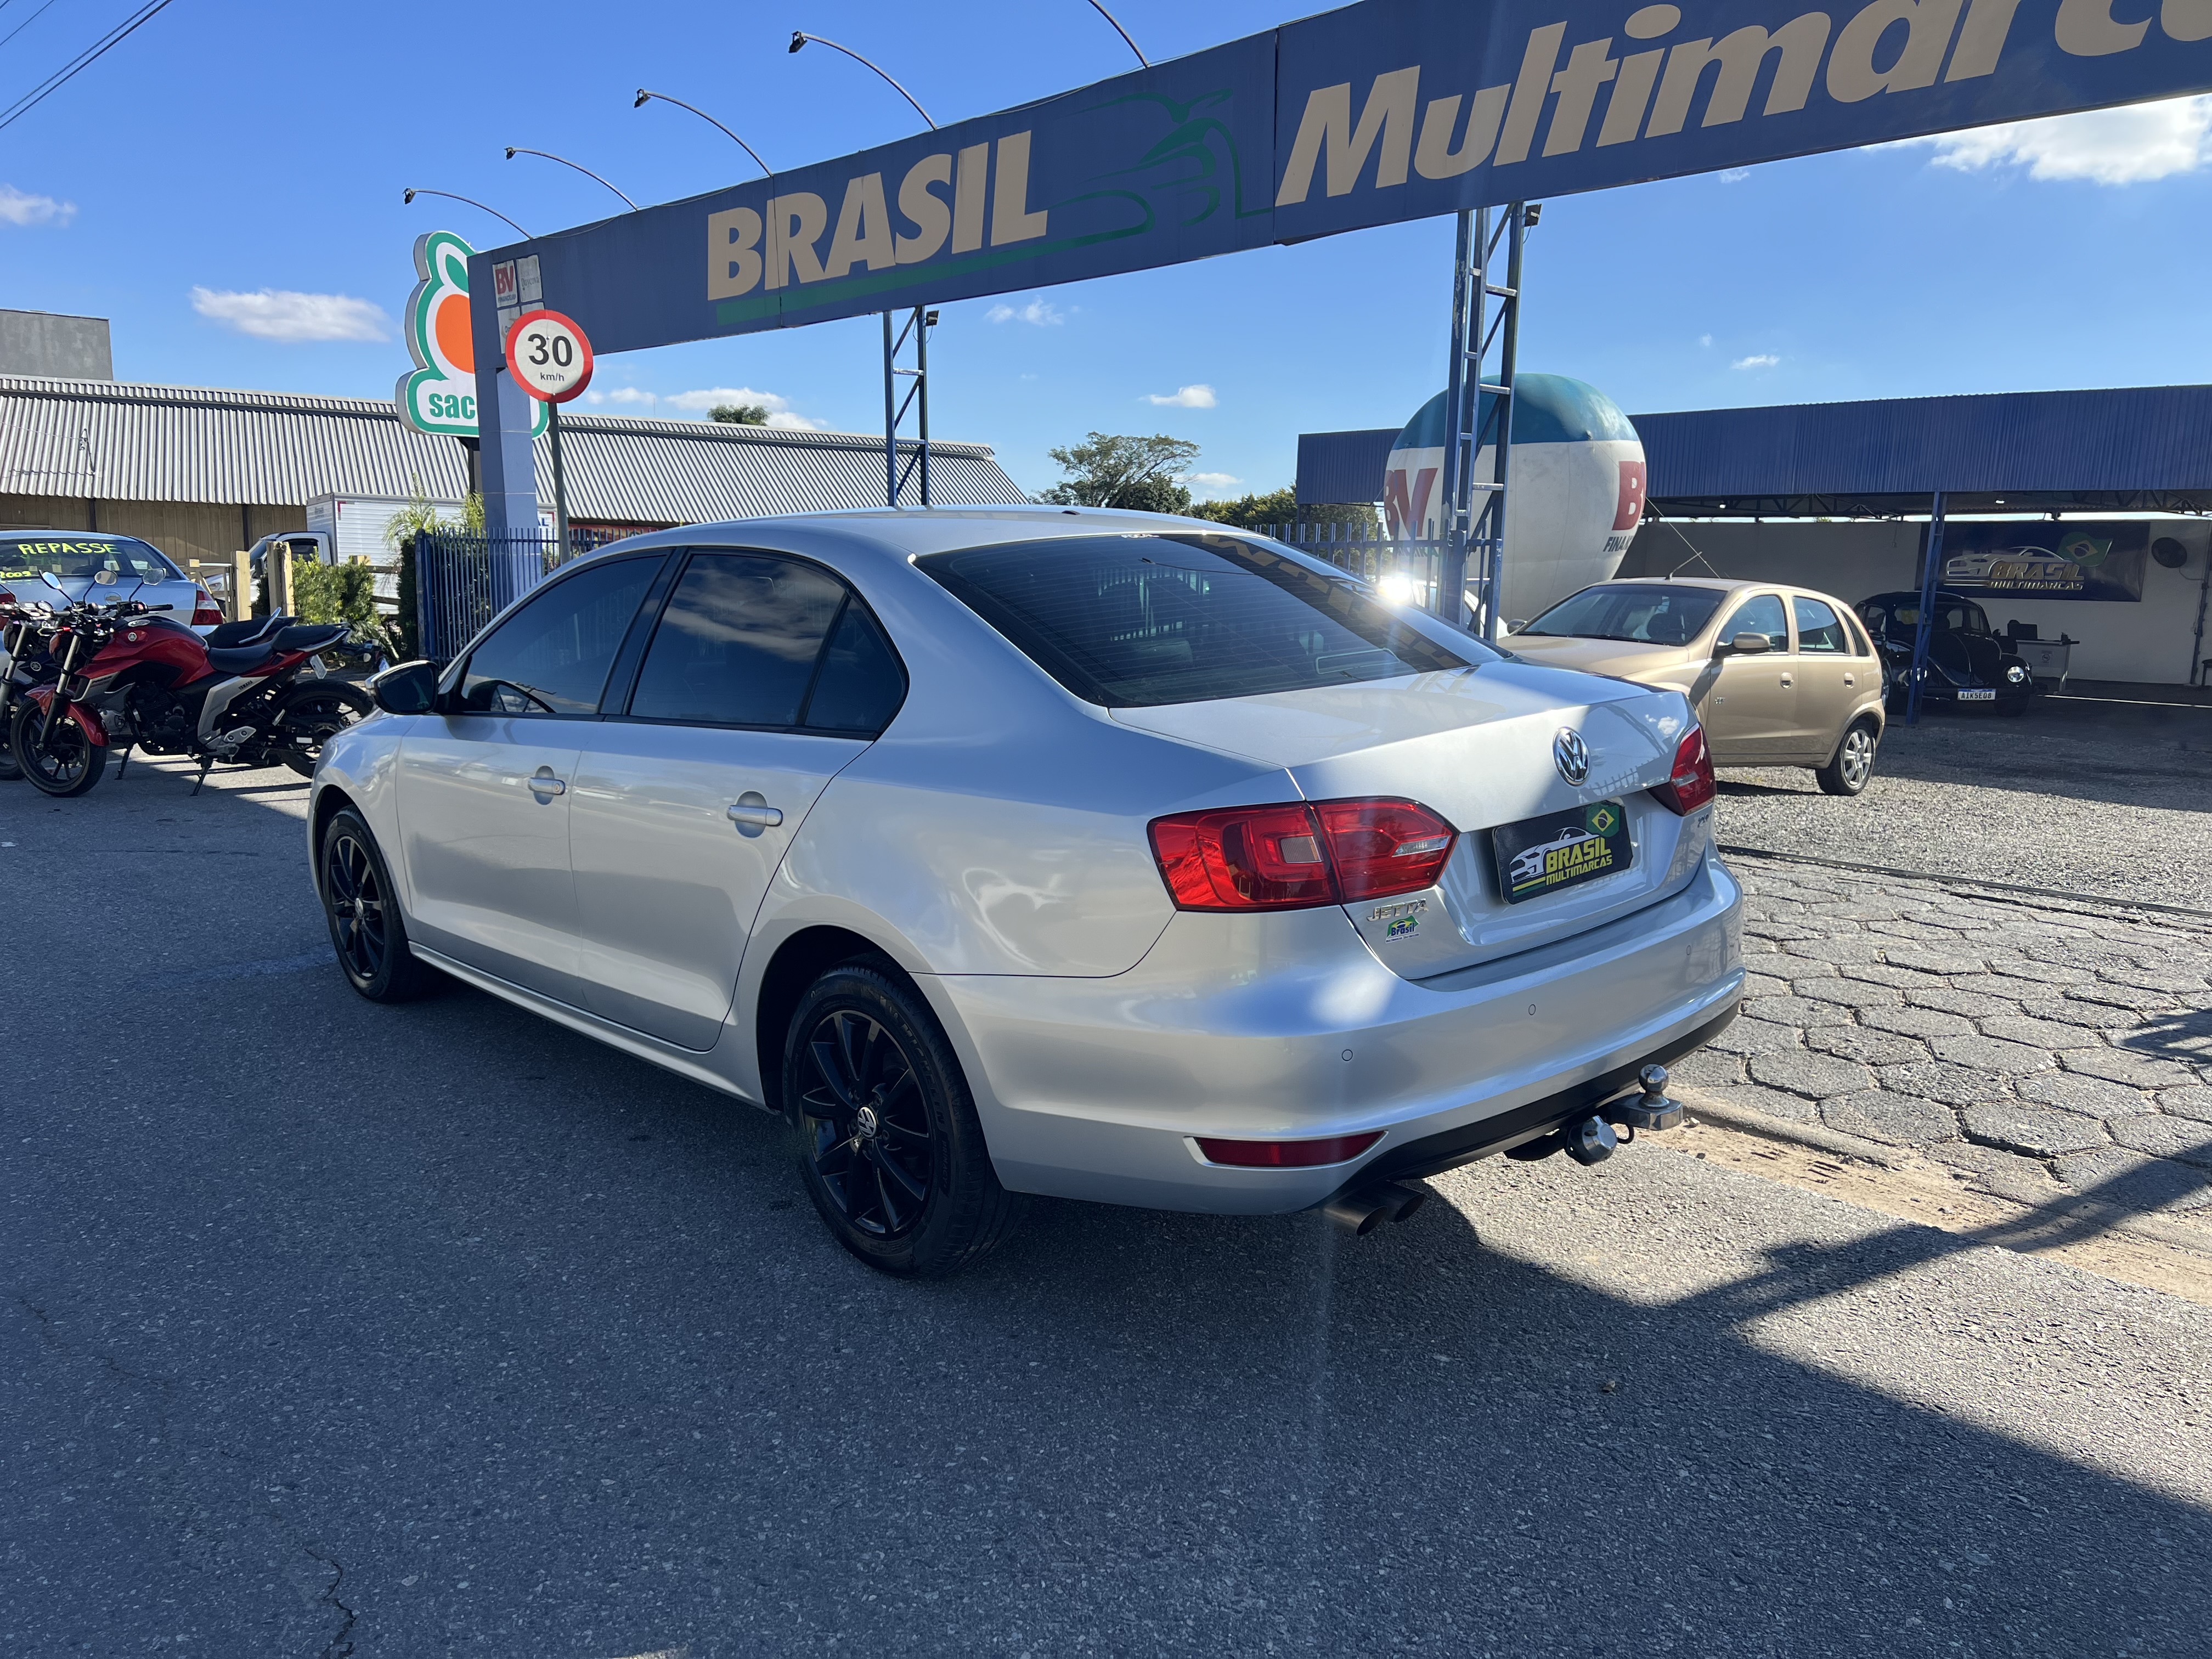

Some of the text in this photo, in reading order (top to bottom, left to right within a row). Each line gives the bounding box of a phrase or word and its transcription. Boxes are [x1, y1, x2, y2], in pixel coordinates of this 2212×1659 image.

[708, 130, 1048, 300] BRASIL
[495, 266, 514, 295] BV
[528, 334, 572, 367] 30
[540, 372, 565, 382] km/h
[428, 393, 476, 419] sac
[18, 543, 122, 555] REPASSE
[1991, 562, 2085, 581] BRASIL
[1546, 837, 1611, 874] BRASIL
[1546, 855, 1613, 885] MULTIMARCAS
[1367, 898, 1429, 922] JETTA
[1391, 922, 1415, 936] Brasil
